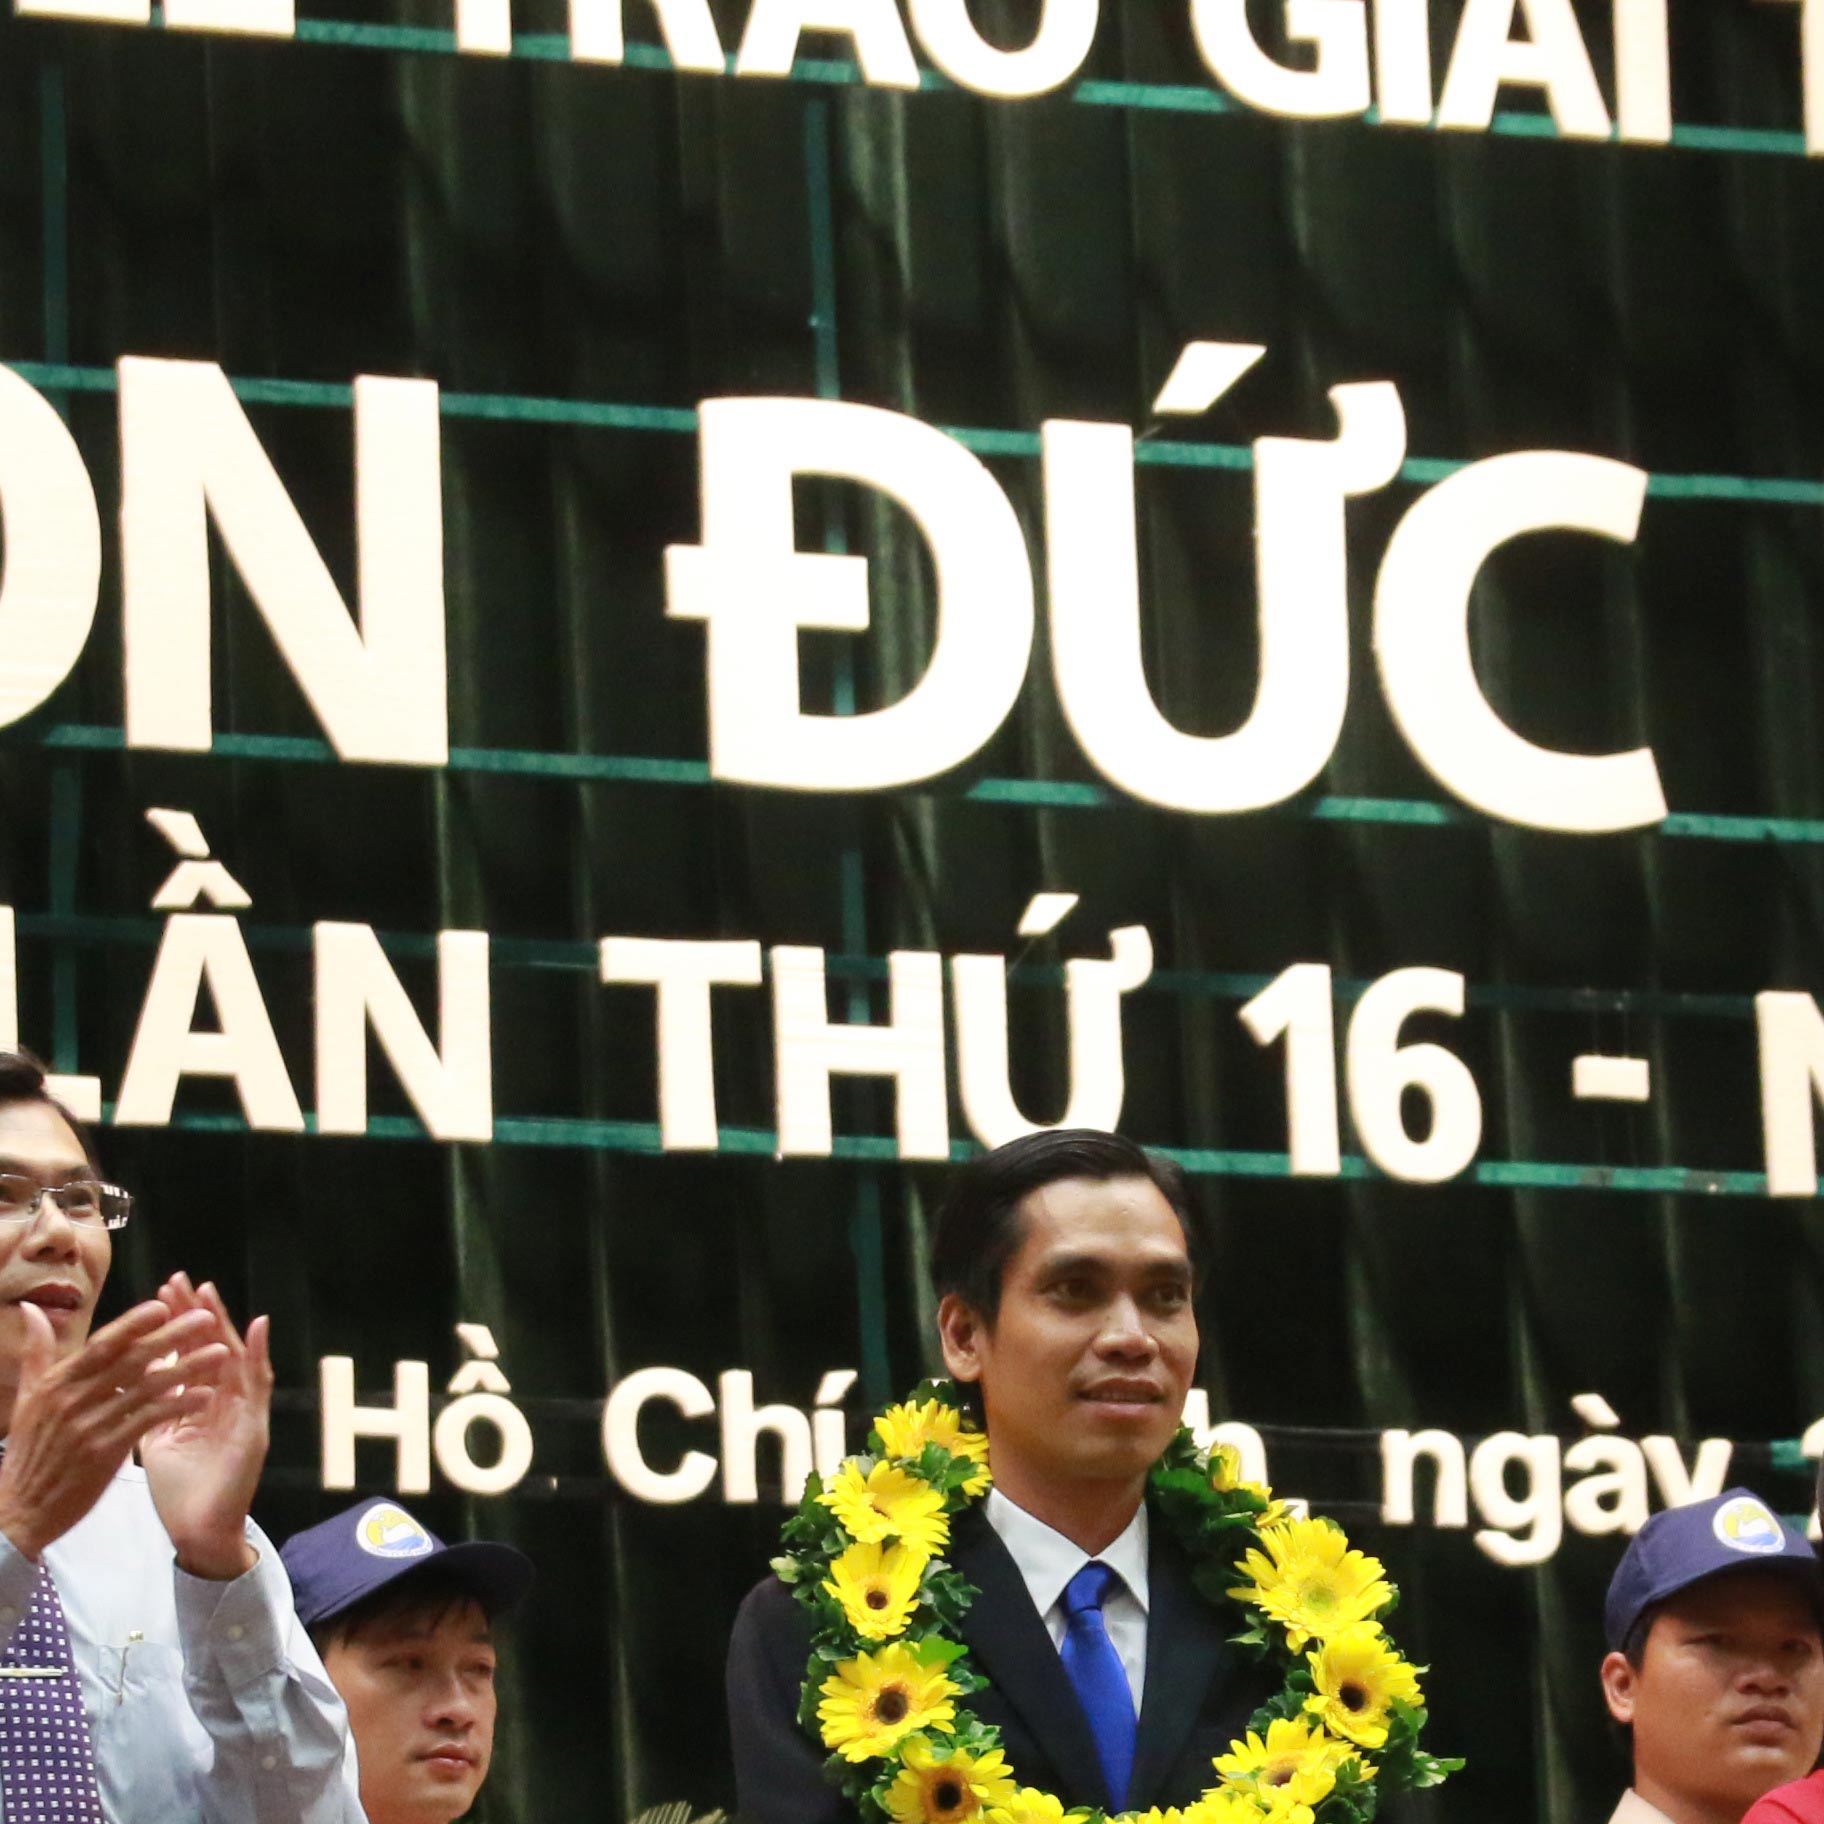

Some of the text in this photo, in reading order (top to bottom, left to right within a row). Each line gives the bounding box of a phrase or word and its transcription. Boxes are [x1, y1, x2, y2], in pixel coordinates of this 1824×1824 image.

[664, 341, 1669, 832] ĐỨC
[599, 892, 1153, 1160] THỨ
[1239, 963, 1482, 1182] 16
[321, 1322, 534, 1494] Hồ
[603, 1366, 860, 1505] Chí
[1381, 1393, 1734, 1564] ngày
